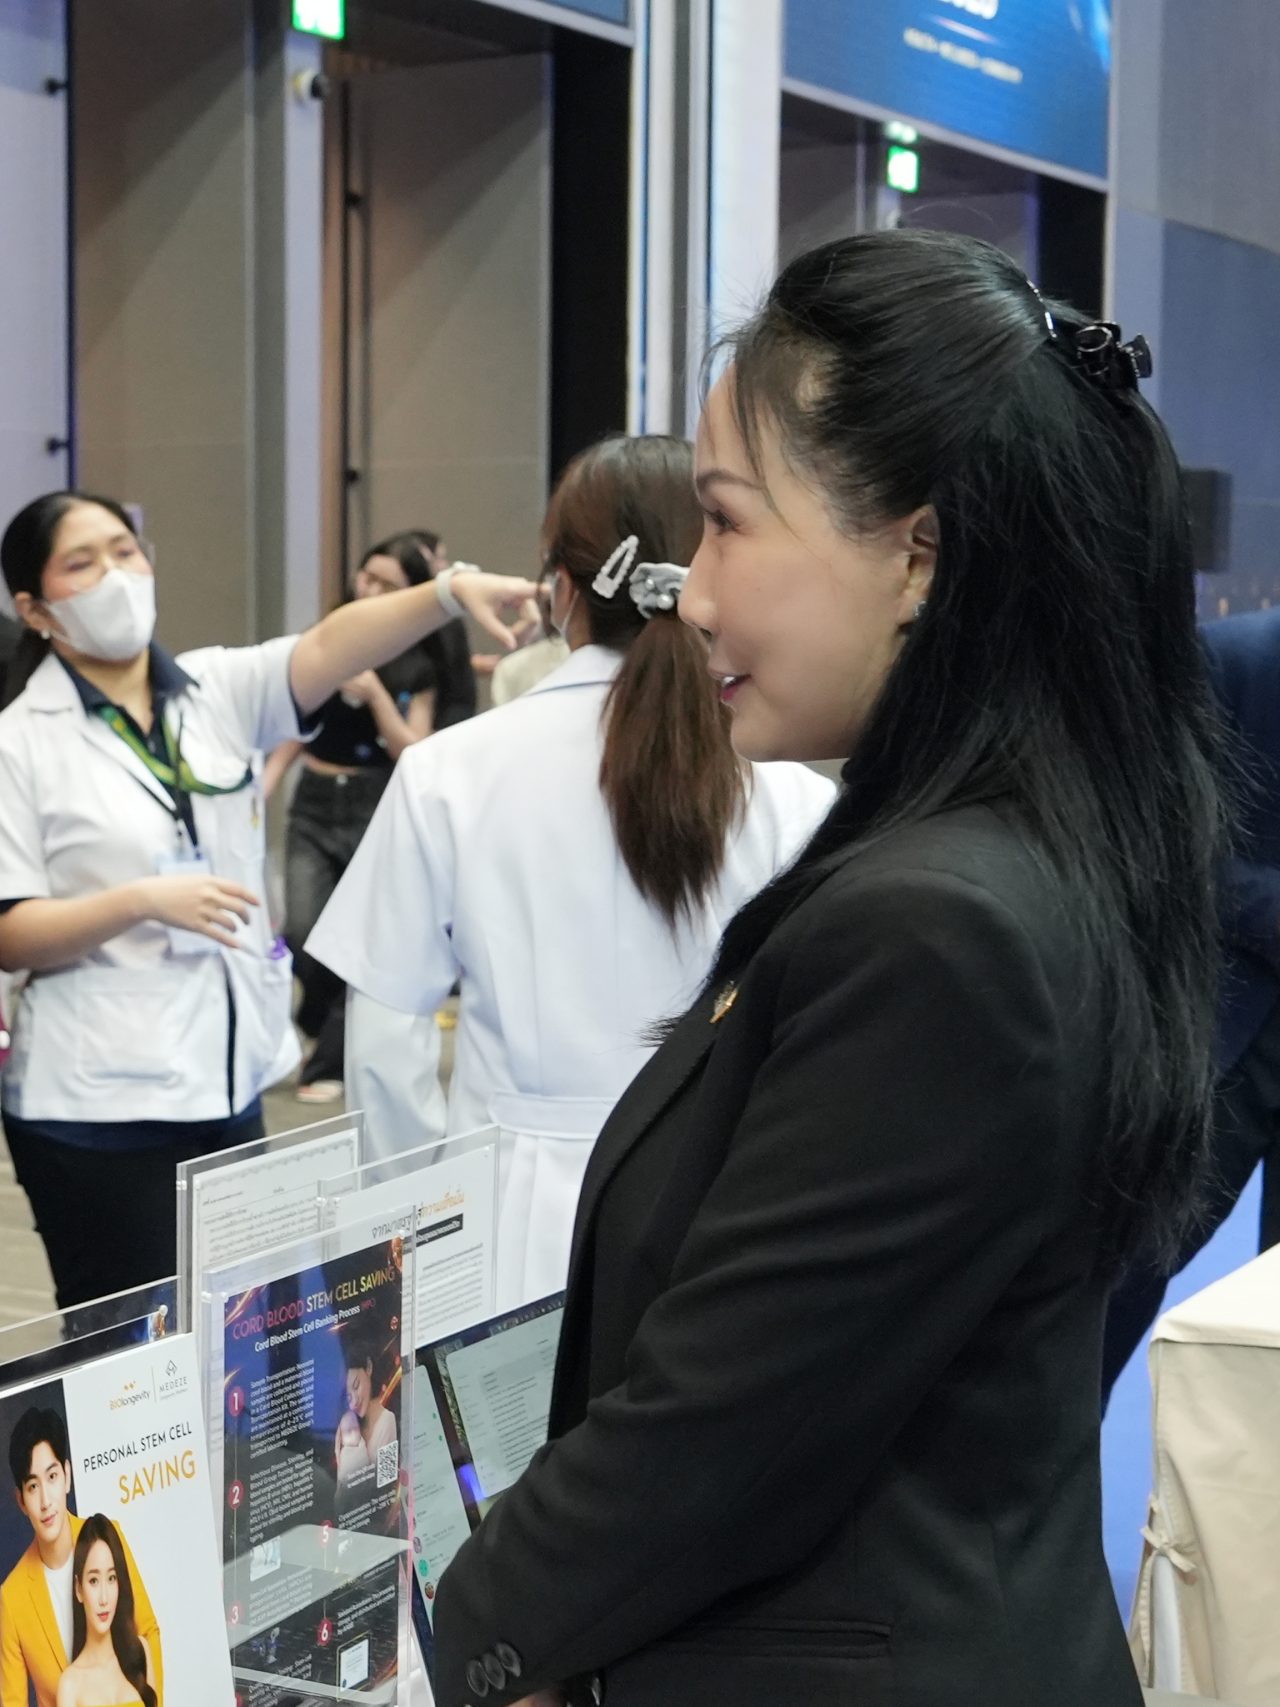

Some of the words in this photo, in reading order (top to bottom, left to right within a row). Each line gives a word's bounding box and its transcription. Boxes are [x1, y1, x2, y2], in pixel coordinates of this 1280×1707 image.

[233, 1316, 264, 1340] CORD
[267, 1300, 304, 1328] BLOOD
[306, 1290, 334, 1312] STEM
[335, 1280, 358, 1300] CELL
[360, 1266, 394, 1292] SAVING
[255, 1338, 270, 1352] Cord
[270, 1331, 288, 1346] Blood
[288, 1326, 303, 1339] Stem
[304, 1321, 314, 1334] Cell
[316, 1313, 338, 1329] Banking
[338, 1305, 360, 1319] Process
[160, 1376, 188, 1392] MEDEZE
[233, 1392, 238, 1410] 1
[84, 1441, 138, 1472] PERSONAL
[140, 1431, 166, 1452] STEM
[169, 1421, 192, 1440] CELL
[119, 1450, 196, 1504] SAVING
[232, 1486, 240, 1505] 2
[322, 1526, 328, 1543] 5
[232, 1606, 238, 1624] 3
[322, 1624, 328, 1642] 6
